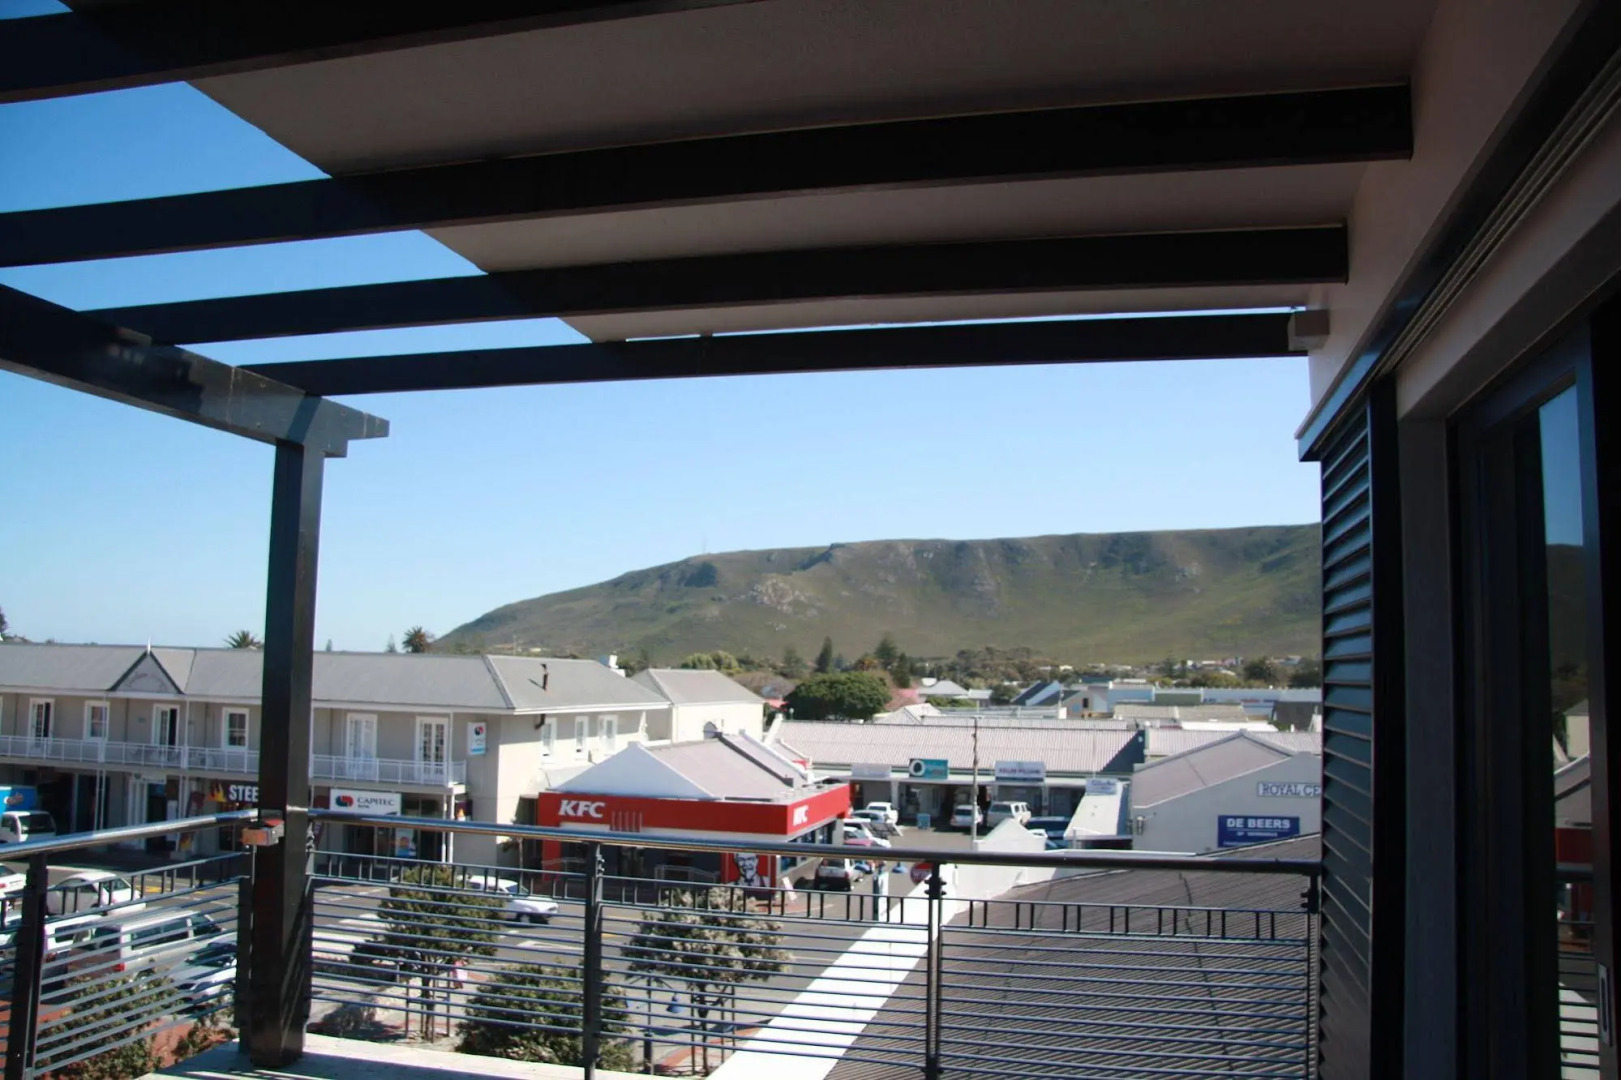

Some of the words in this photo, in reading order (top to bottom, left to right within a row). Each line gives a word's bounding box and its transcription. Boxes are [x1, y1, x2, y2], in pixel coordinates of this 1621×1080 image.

[229, 785, 259, 802] STEE
[1261, 783, 1301, 796] ROYAL
[357, 797, 395, 806] CAPITEC
[558, 799, 605, 818] KFC
[792, 804, 809, 826] KFC
[1226, 818, 1244, 828] DE
[1247, 818, 1291, 829] BEERS
